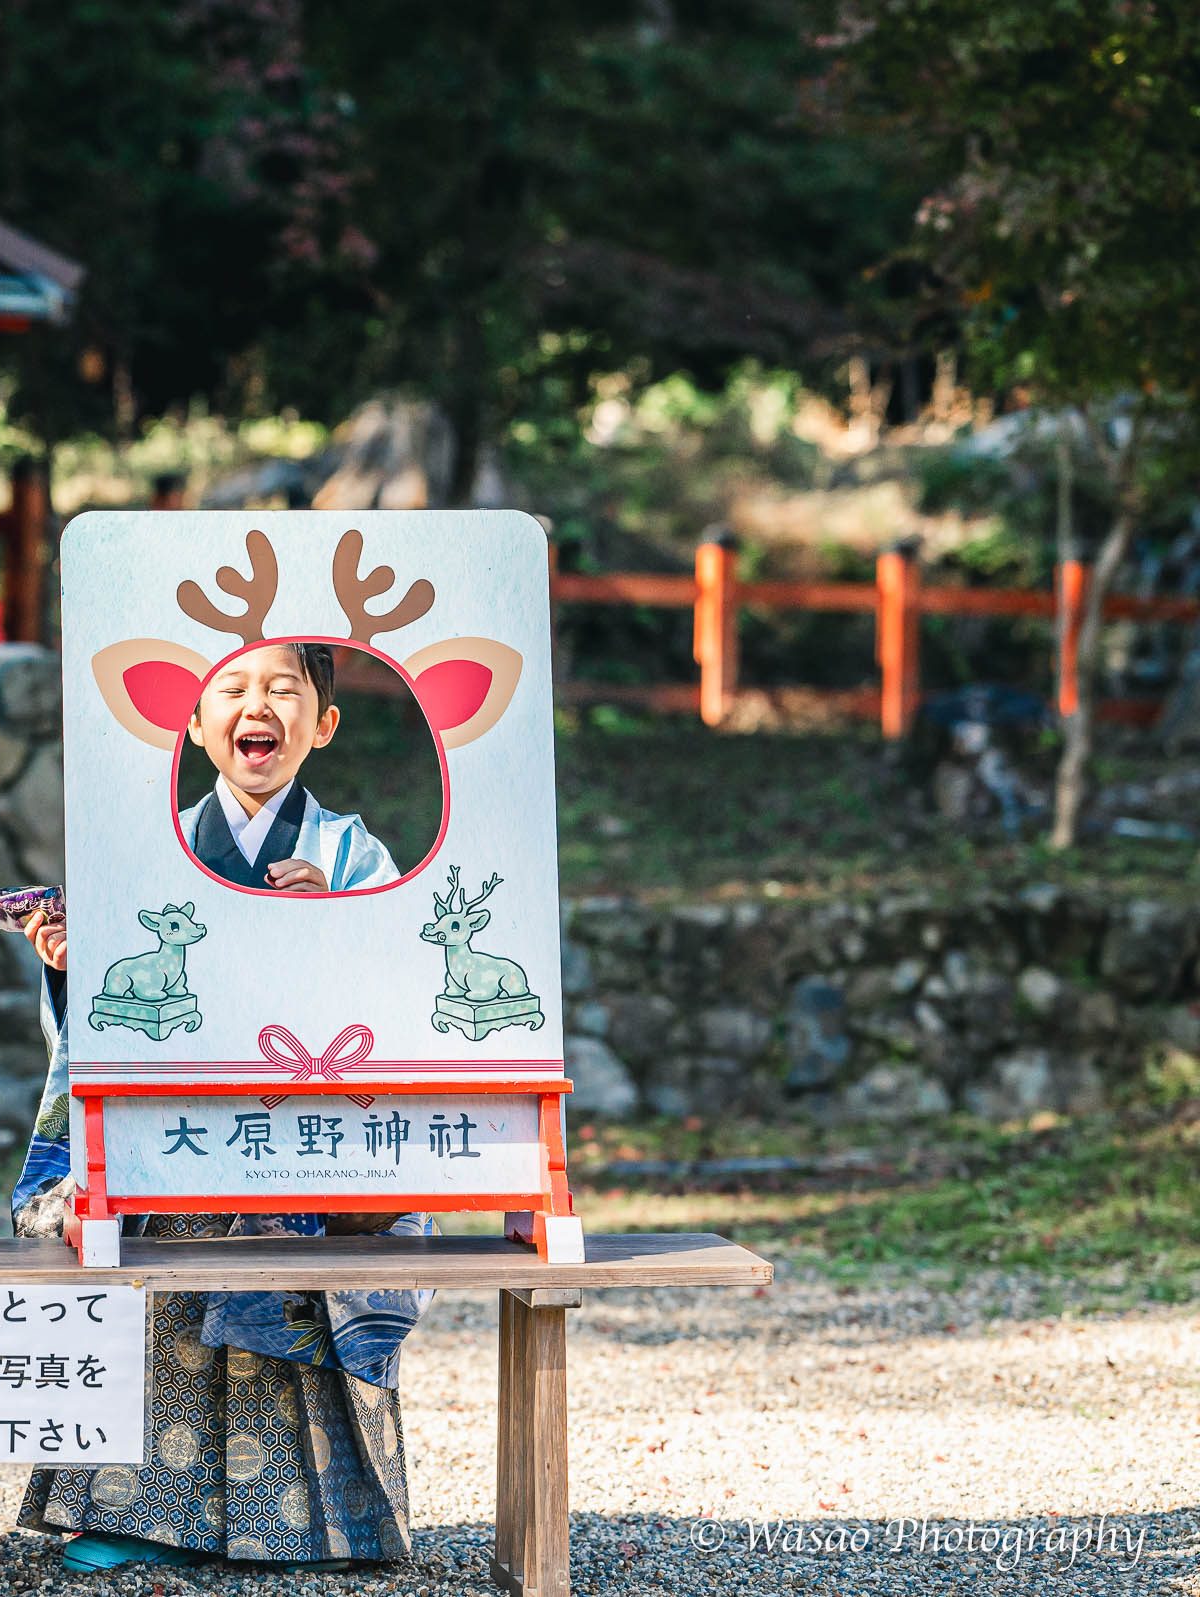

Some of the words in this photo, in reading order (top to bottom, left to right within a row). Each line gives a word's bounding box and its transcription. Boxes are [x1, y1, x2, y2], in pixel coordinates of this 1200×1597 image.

[162, 1110, 482, 1166] 大原野神社
[245, 1169, 291, 1180] KYOTO
[296, 1169, 398, 1180] OHARANO-JINJA
